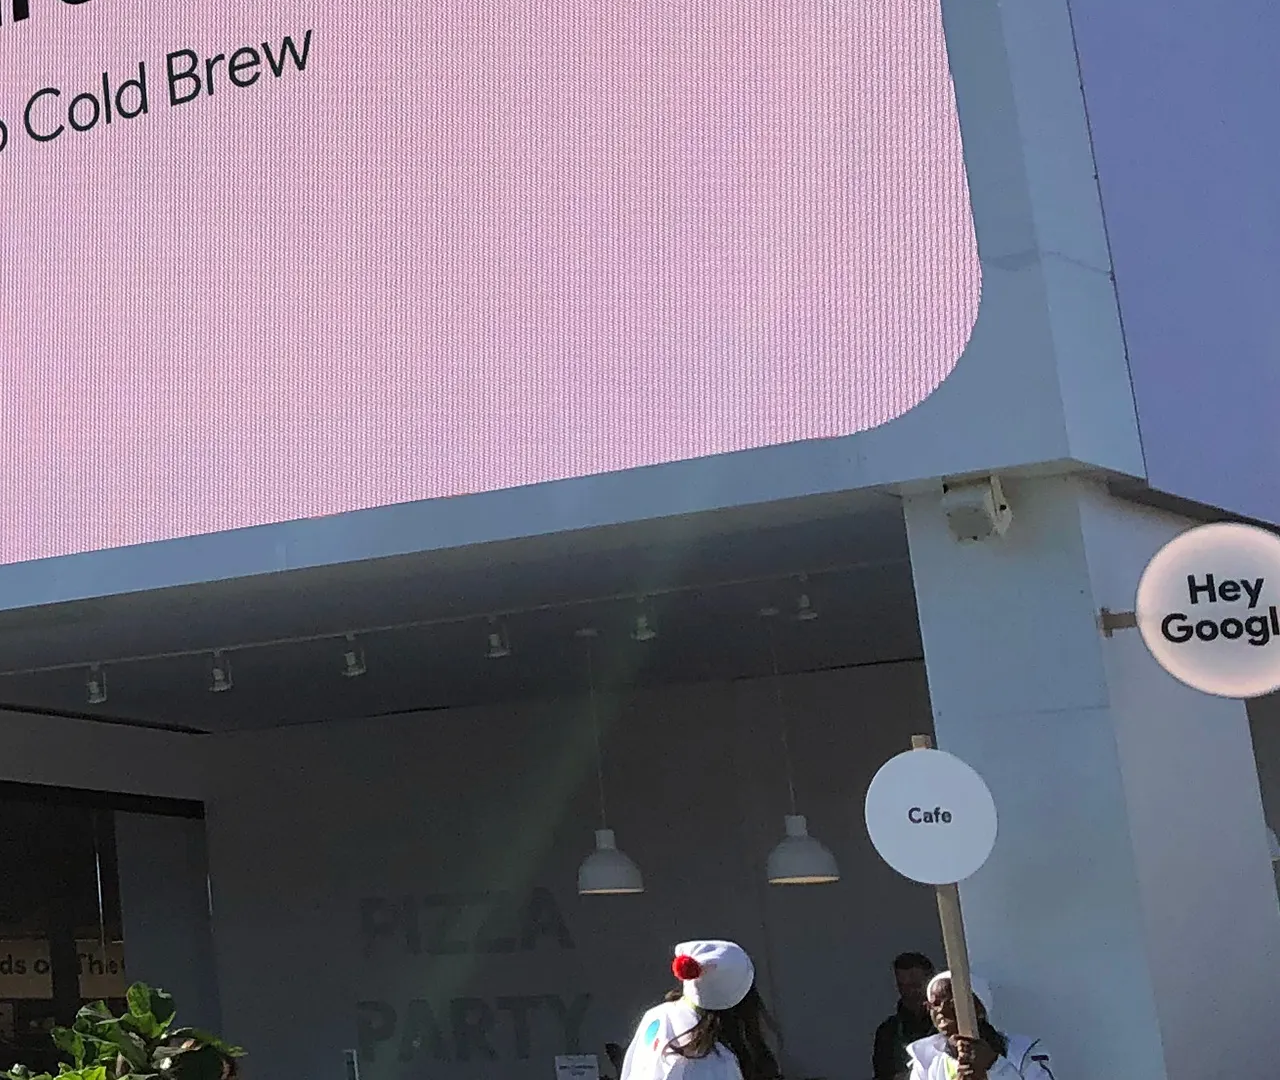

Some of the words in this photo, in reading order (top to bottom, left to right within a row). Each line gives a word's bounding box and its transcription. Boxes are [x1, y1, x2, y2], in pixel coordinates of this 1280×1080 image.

[22, 60, 150, 143] Cold
[165, 28, 314, 107] Brew
[1186, 573, 1265, 610] Hey
[1161, 605, 1280, 647] Googl
[907, 806, 953, 824] Cafe
[358, 886, 577, 957] PIZZA
[355, 992, 594, 1063] PARTY
